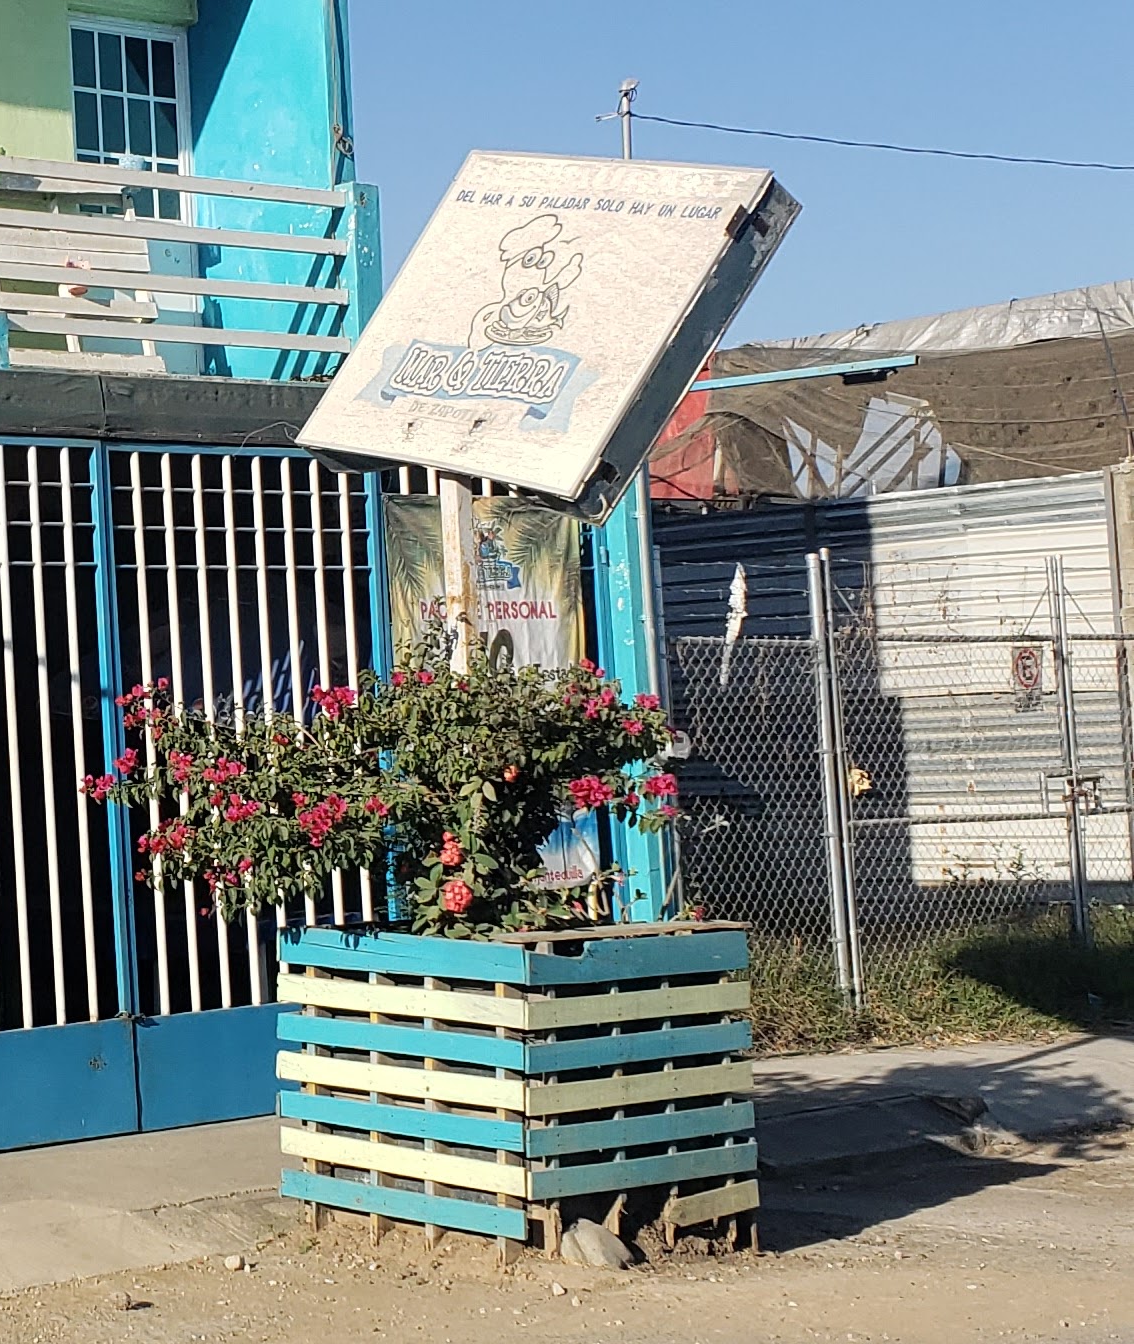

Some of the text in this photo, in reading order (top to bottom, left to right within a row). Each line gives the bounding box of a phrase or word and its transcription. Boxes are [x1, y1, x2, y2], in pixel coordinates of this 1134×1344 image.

[456, 189, 723, 220] DEL MAR A SU PALADAR SOLO HAY UN LUGAR
[393, 346, 450, 393] MAR
[472, 350, 565, 400] TIERRA
[488, 601, 557, 620] PERSONAL
